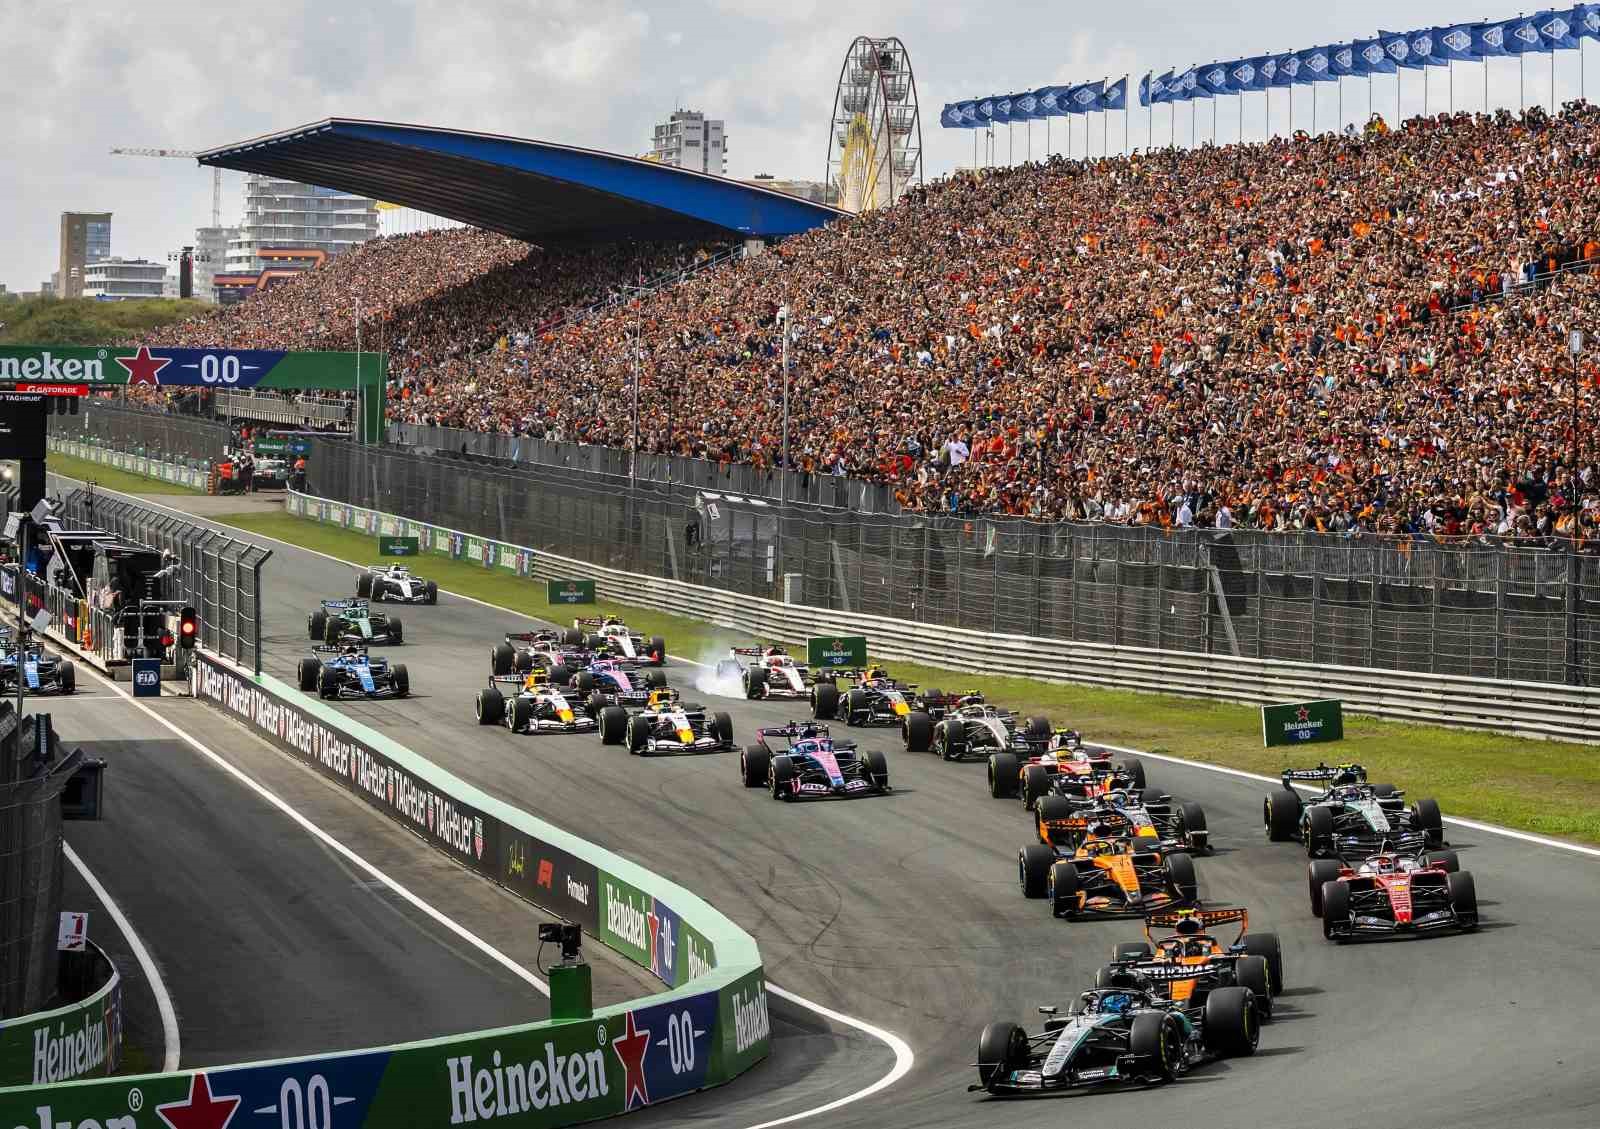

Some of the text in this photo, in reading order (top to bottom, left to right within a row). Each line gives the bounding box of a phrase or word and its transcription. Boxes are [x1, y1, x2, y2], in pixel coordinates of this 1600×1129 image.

[201, 355, 240, 383] 0.0
[137, 673, 156, 682] FIA
[1284, 721, 1323, 731] Heineken
[607, 883, 646, 951] Heineken
[33, 1013, 104, 1085] Heineken
[447, 1010, 695, 1125] Heineken 0.0
